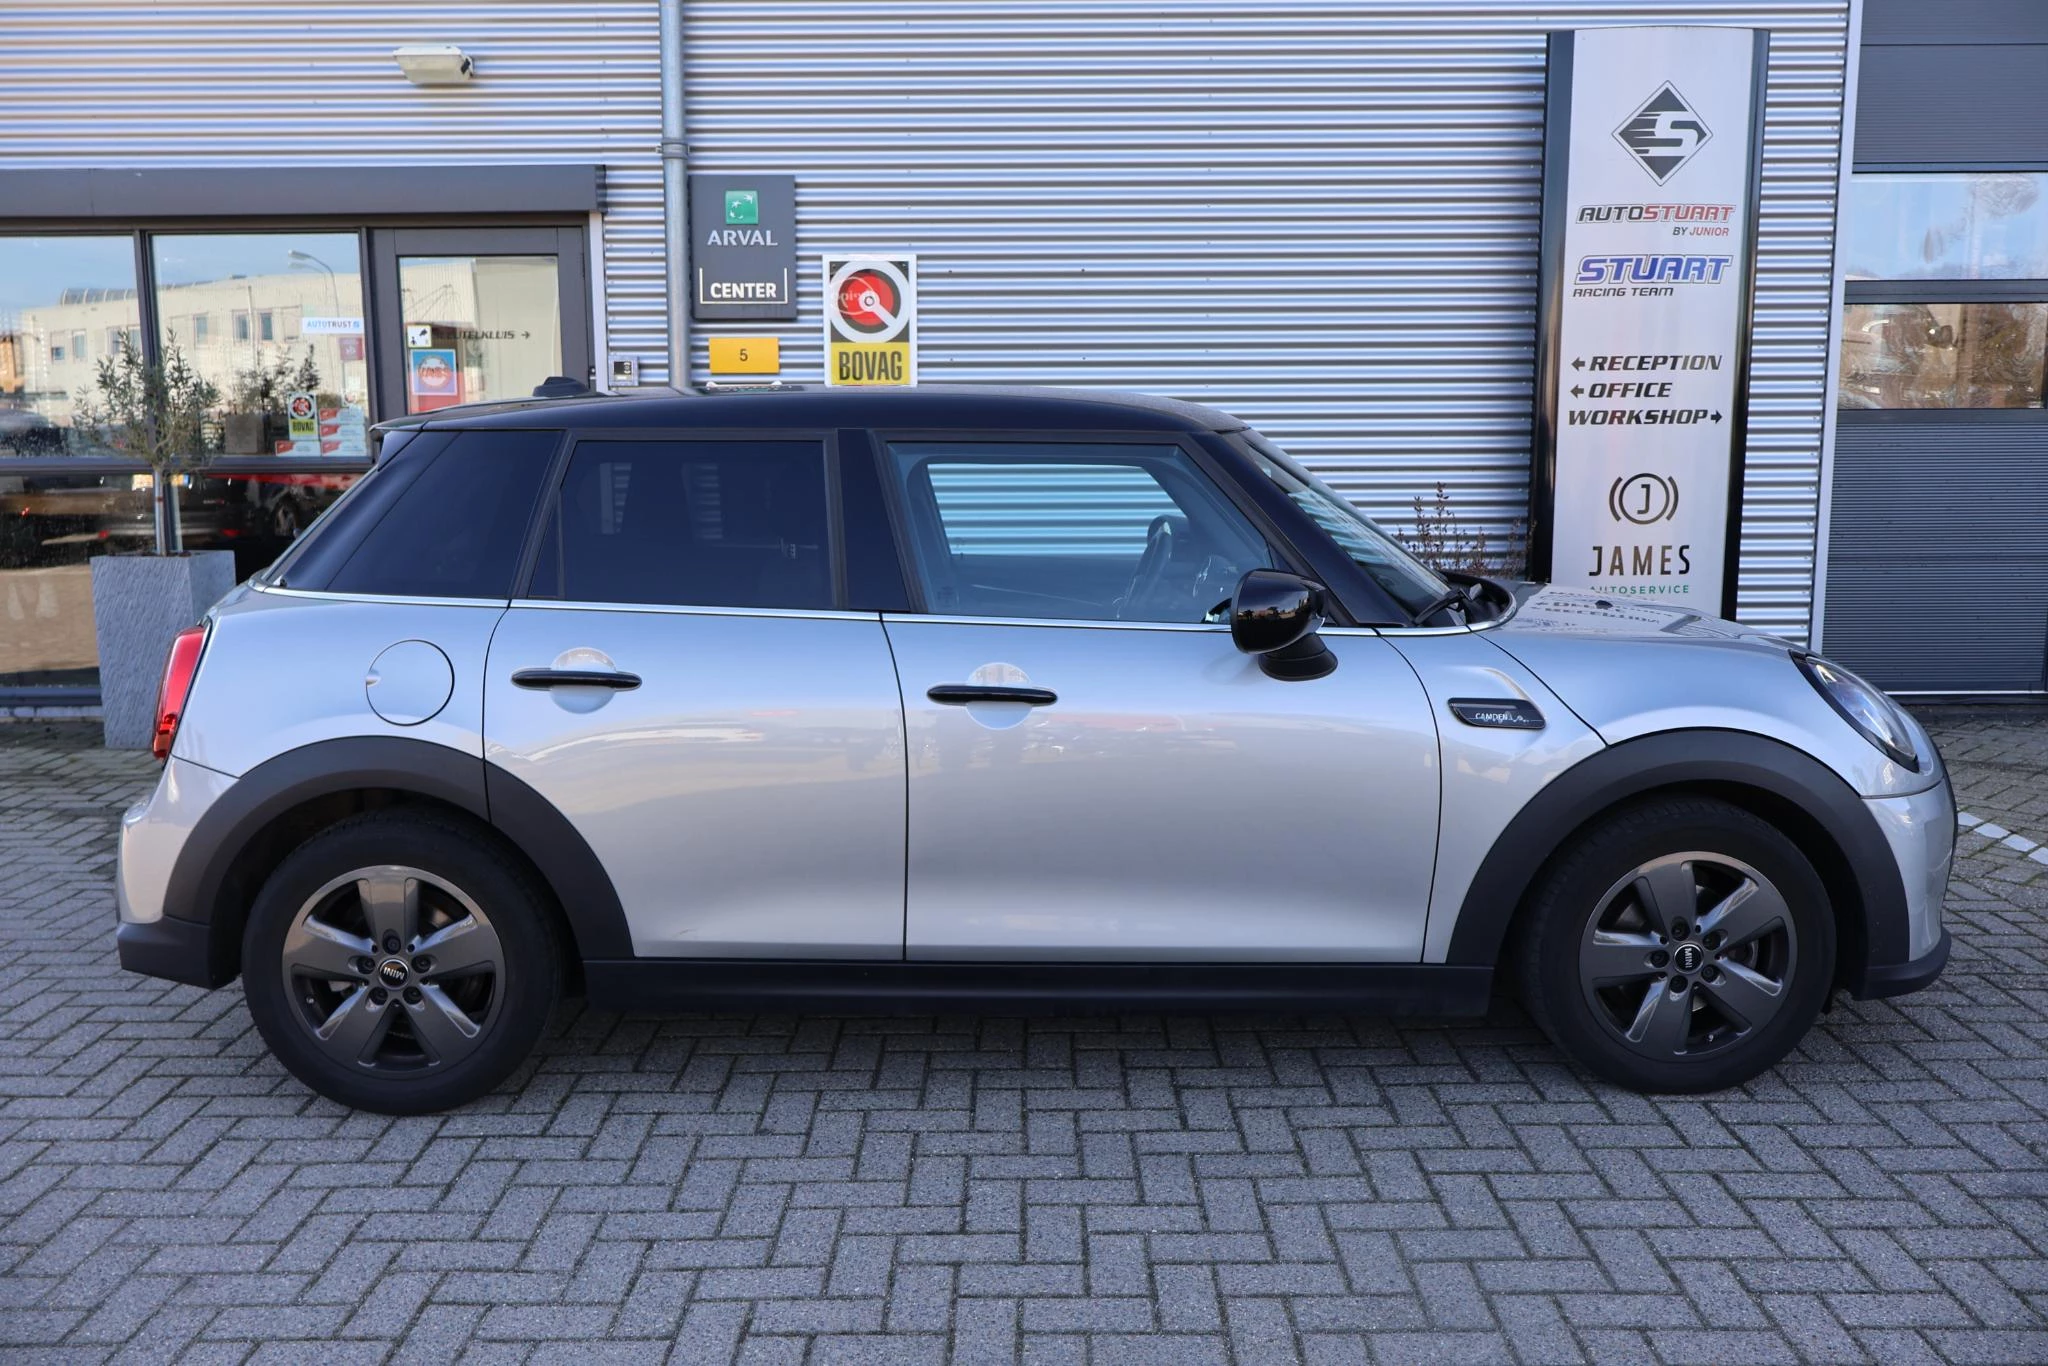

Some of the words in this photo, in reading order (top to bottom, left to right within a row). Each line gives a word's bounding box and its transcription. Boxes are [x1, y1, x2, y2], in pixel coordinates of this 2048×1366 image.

[1577, 204, 1735, 223] AUTOSTUART
[707, 229, 778, 247] ARVAL
[1672, 226, 1688, 236] BY
[1689, 226, 1729, 236] JUNIOR
[1576, 255, 1732, 283] STUART
[710, 282, 777, 299] CENTER
[1573, 287, 1626, 298] RACING
[1631, 287, 1674, 297] TEAM
[307, 319, 352, 329] AUTOTRUST
[739, 348, 749, 362] 5
[1589, 355, 1722, 371] RECEPTION
[838, 350, 903, 381] BOVAG
[1588, 382, 1673, 398] OFFICE
[1568, 409, 1708, 425] WORKSHOP
[292, 421, 314, 432] BOVAG
[1637, 484, 1651, 515] J
[1588, 545, 1690, 576] JAMES
[1684, 947, 1693, 969] MINI
[383, 966, 405, 980] MINI
